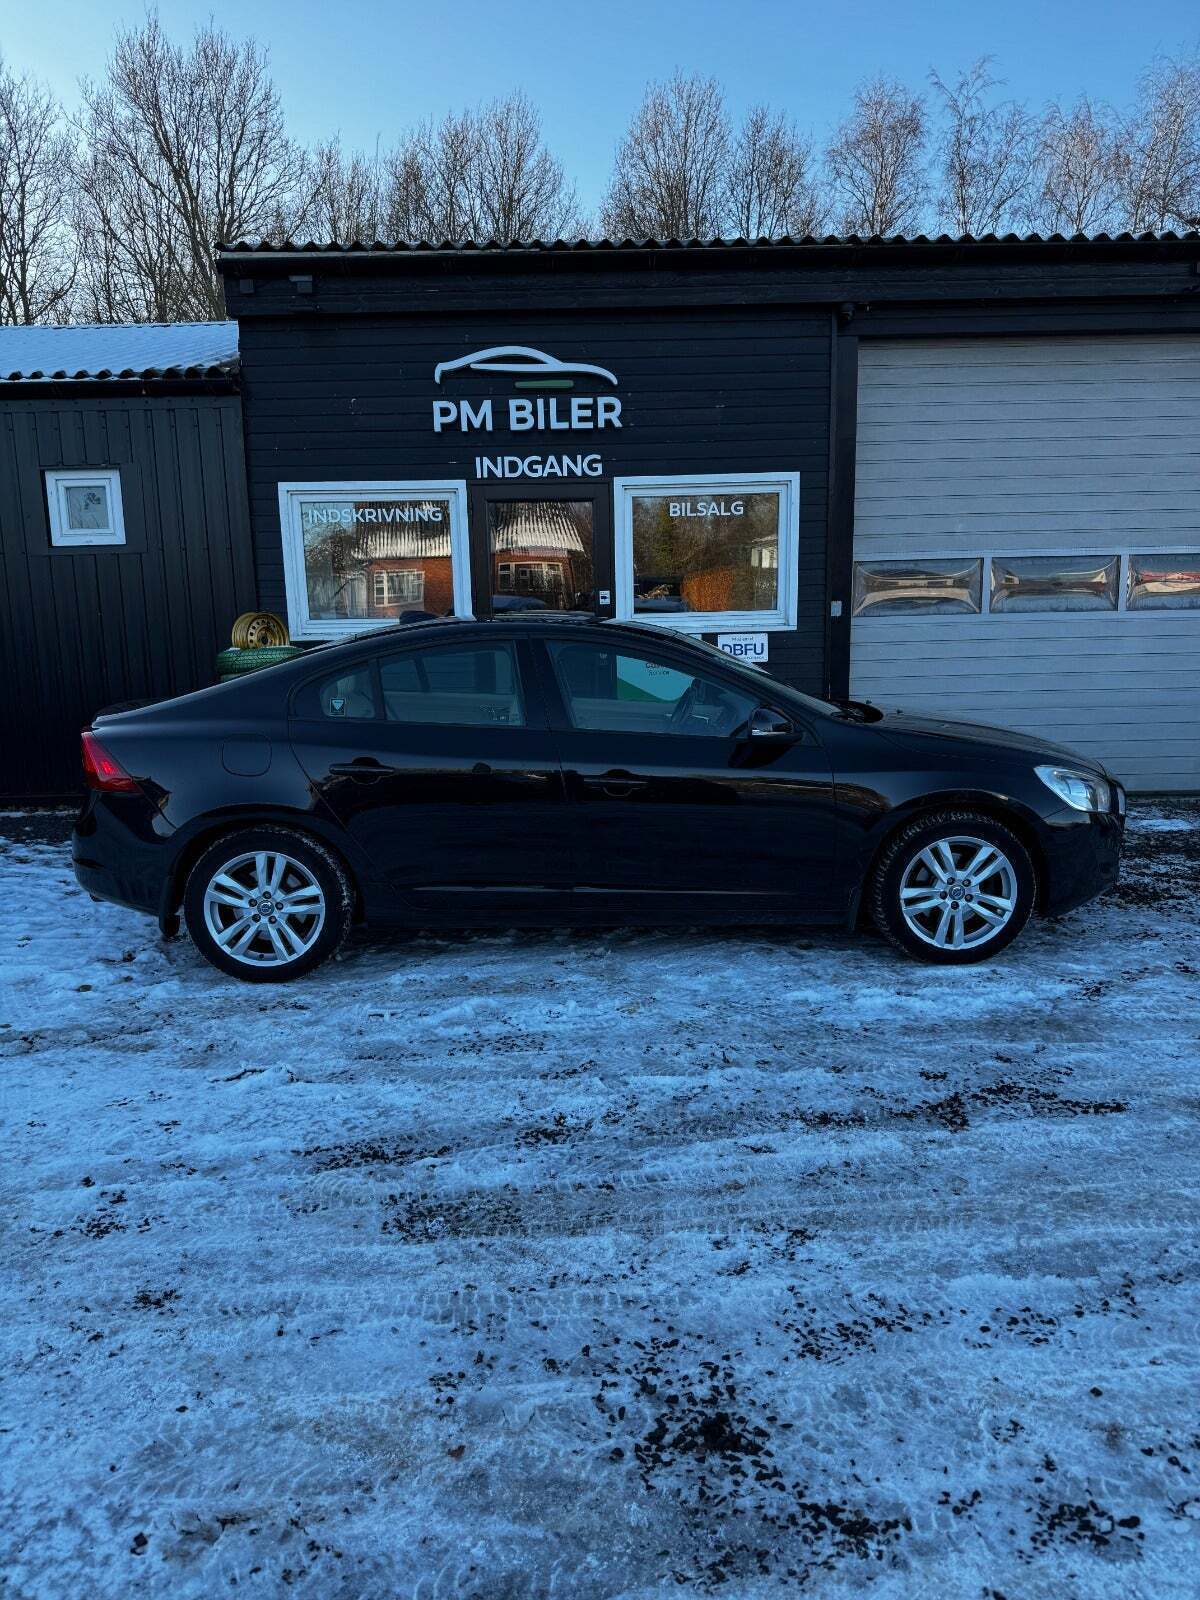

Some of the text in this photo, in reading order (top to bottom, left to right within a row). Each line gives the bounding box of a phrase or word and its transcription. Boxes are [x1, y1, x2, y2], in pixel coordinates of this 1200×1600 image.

[432, 397, 623, 432] PM BILER
[475, 454, 603, 479] INDGANG
[308, 508, 442, 523] INDSKRIVNING
[669, 501, 744, 517] BILSALG
[721, 643, 765, 656] DBFU
